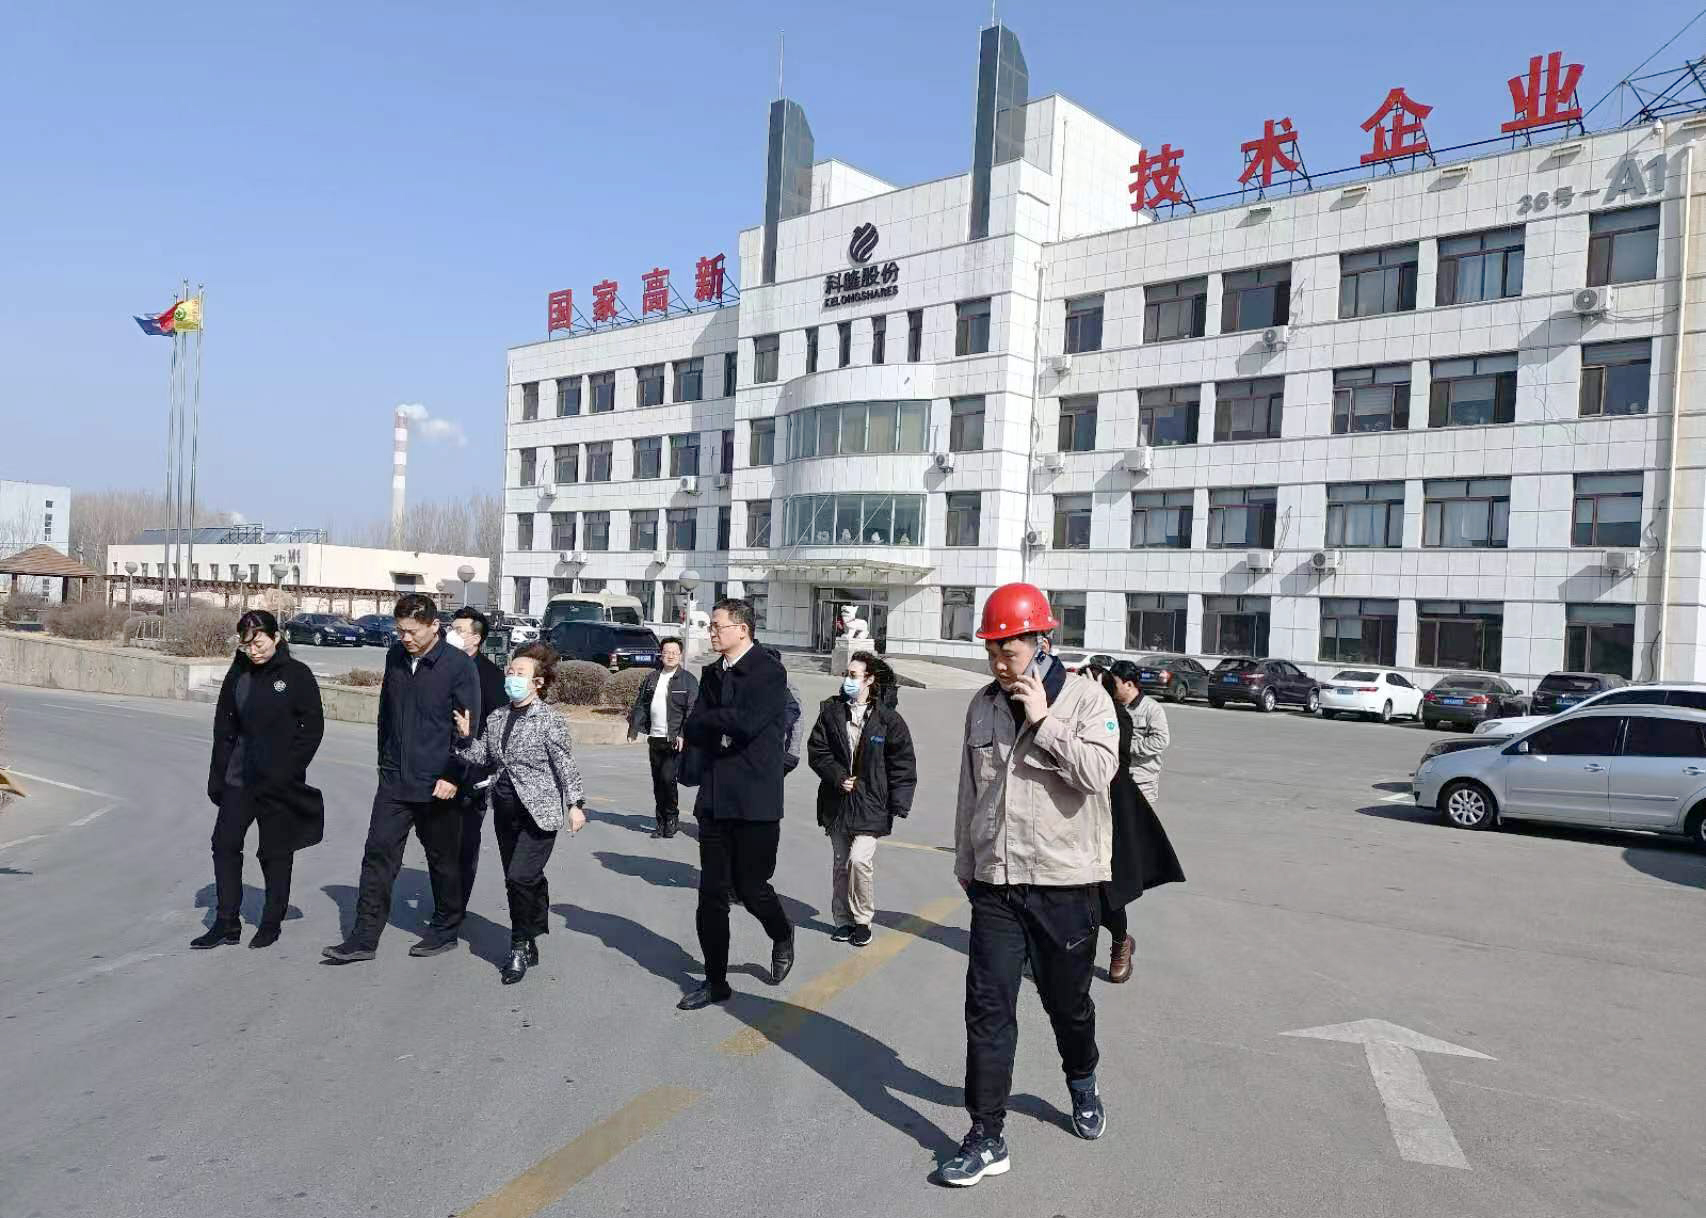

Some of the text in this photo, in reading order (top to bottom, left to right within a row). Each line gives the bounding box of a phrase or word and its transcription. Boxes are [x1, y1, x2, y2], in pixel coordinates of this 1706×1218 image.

[1129, 51, 1586, 212] 技术企业
[548, 253, 725, 333] 国家高新
